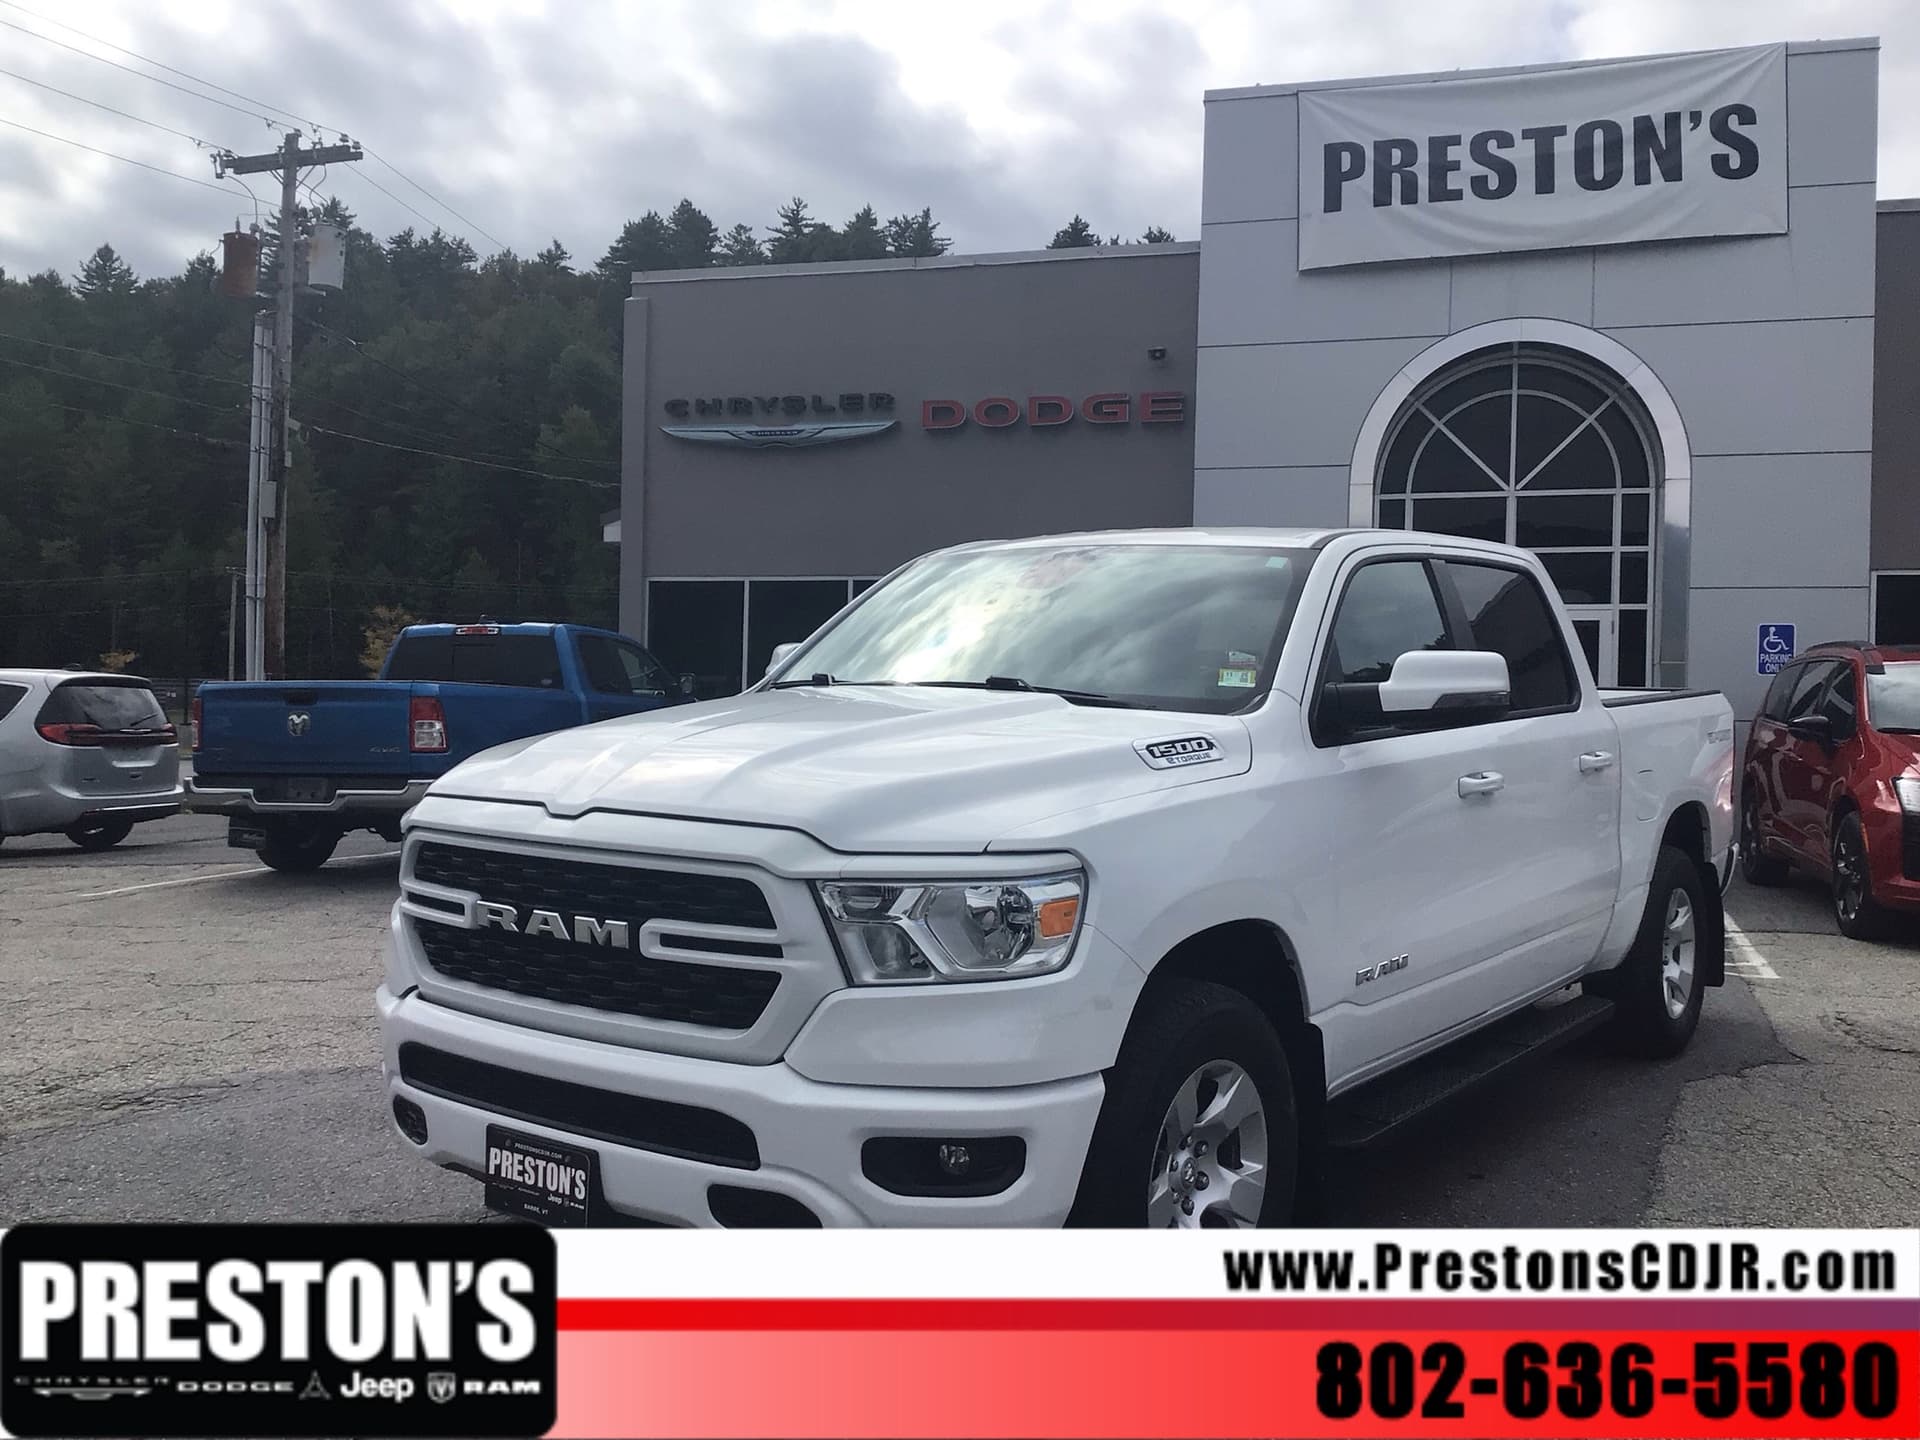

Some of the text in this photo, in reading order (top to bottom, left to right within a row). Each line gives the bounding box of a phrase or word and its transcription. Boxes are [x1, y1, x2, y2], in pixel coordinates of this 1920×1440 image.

[1323, 103, 1760, 213] PRESTON'S
[664, 392, 896, 418] CHRYSLER
[921, 391, 1186, 431] DODGE
[1765, 663, 1784, 673] ONL
[1150, 739, 1209, 757] 1500
[476, 900, 630, 949] RAM
[1355, 953, 1409, 986] RAM
[488, 1146, 586, 1200] PRESTON'S
